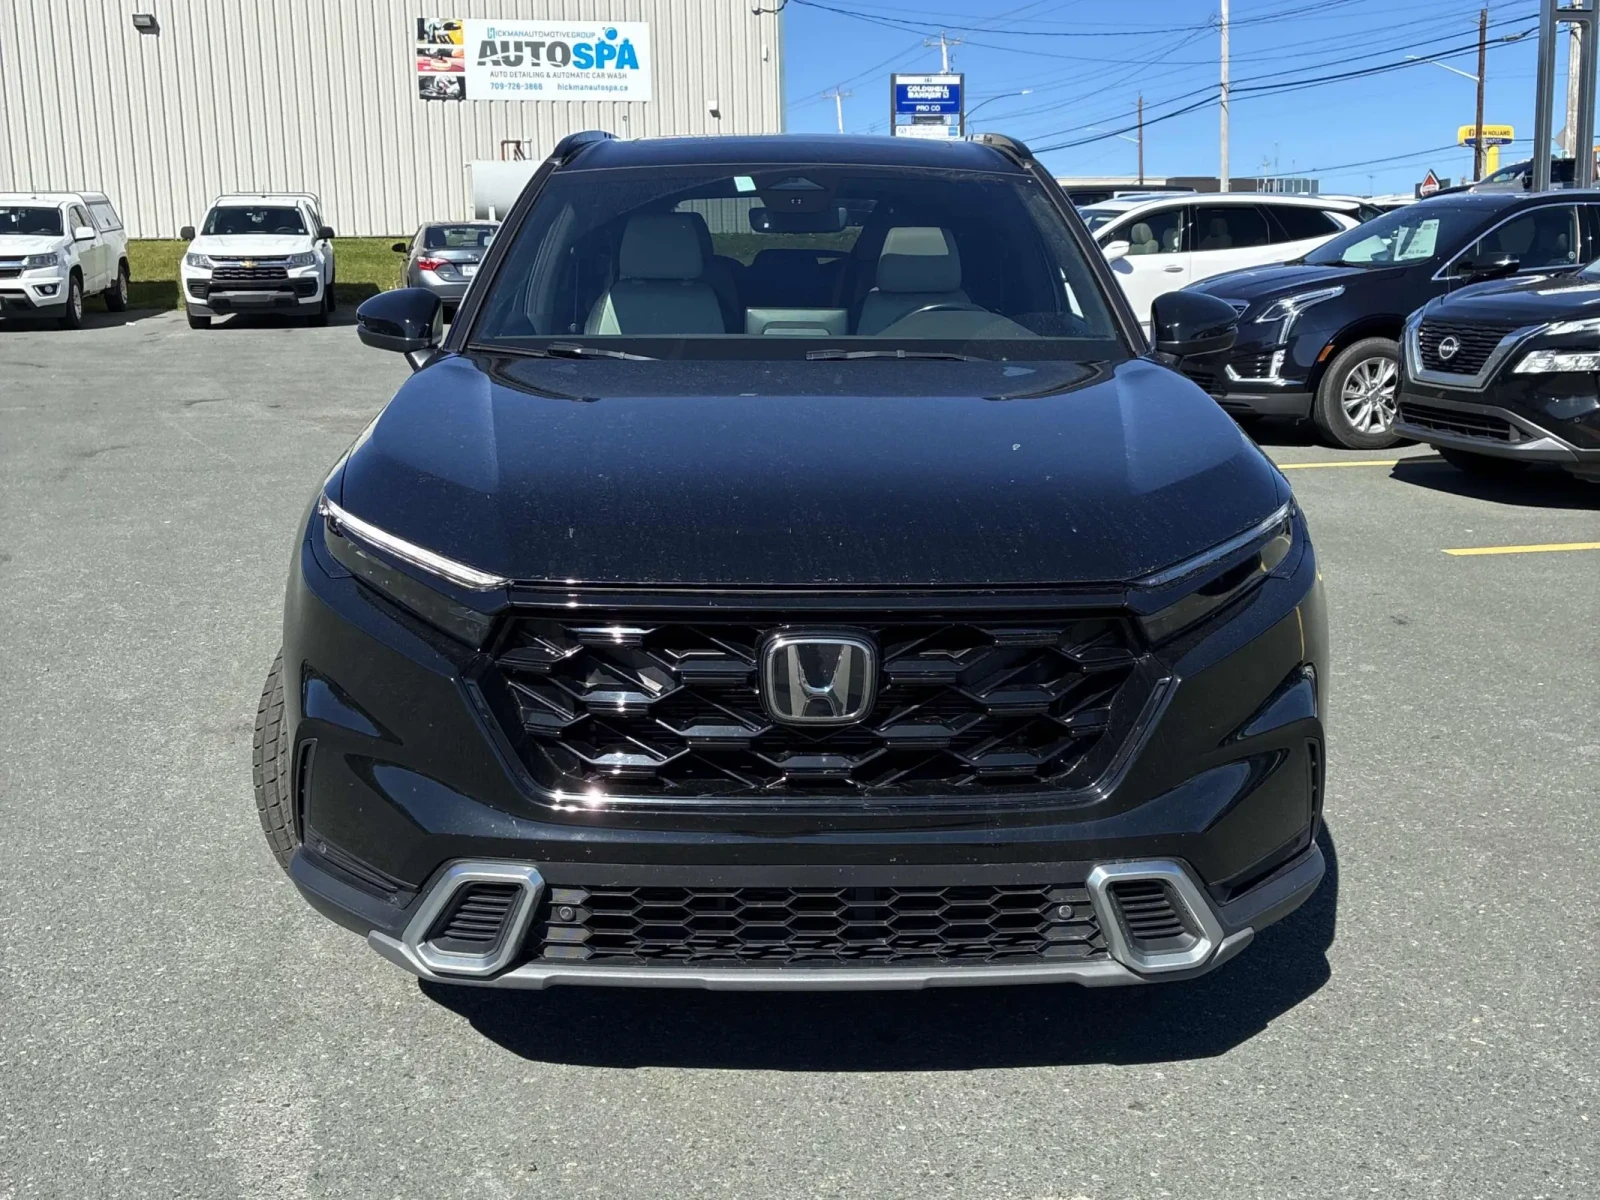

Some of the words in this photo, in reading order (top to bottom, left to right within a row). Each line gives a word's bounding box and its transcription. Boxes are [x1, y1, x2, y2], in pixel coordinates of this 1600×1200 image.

[509, 71, 544, 79] DETAILING
[607, 72, 628, 80] WASH
[557, 83, 629, 93] hickmanautospa.ca
